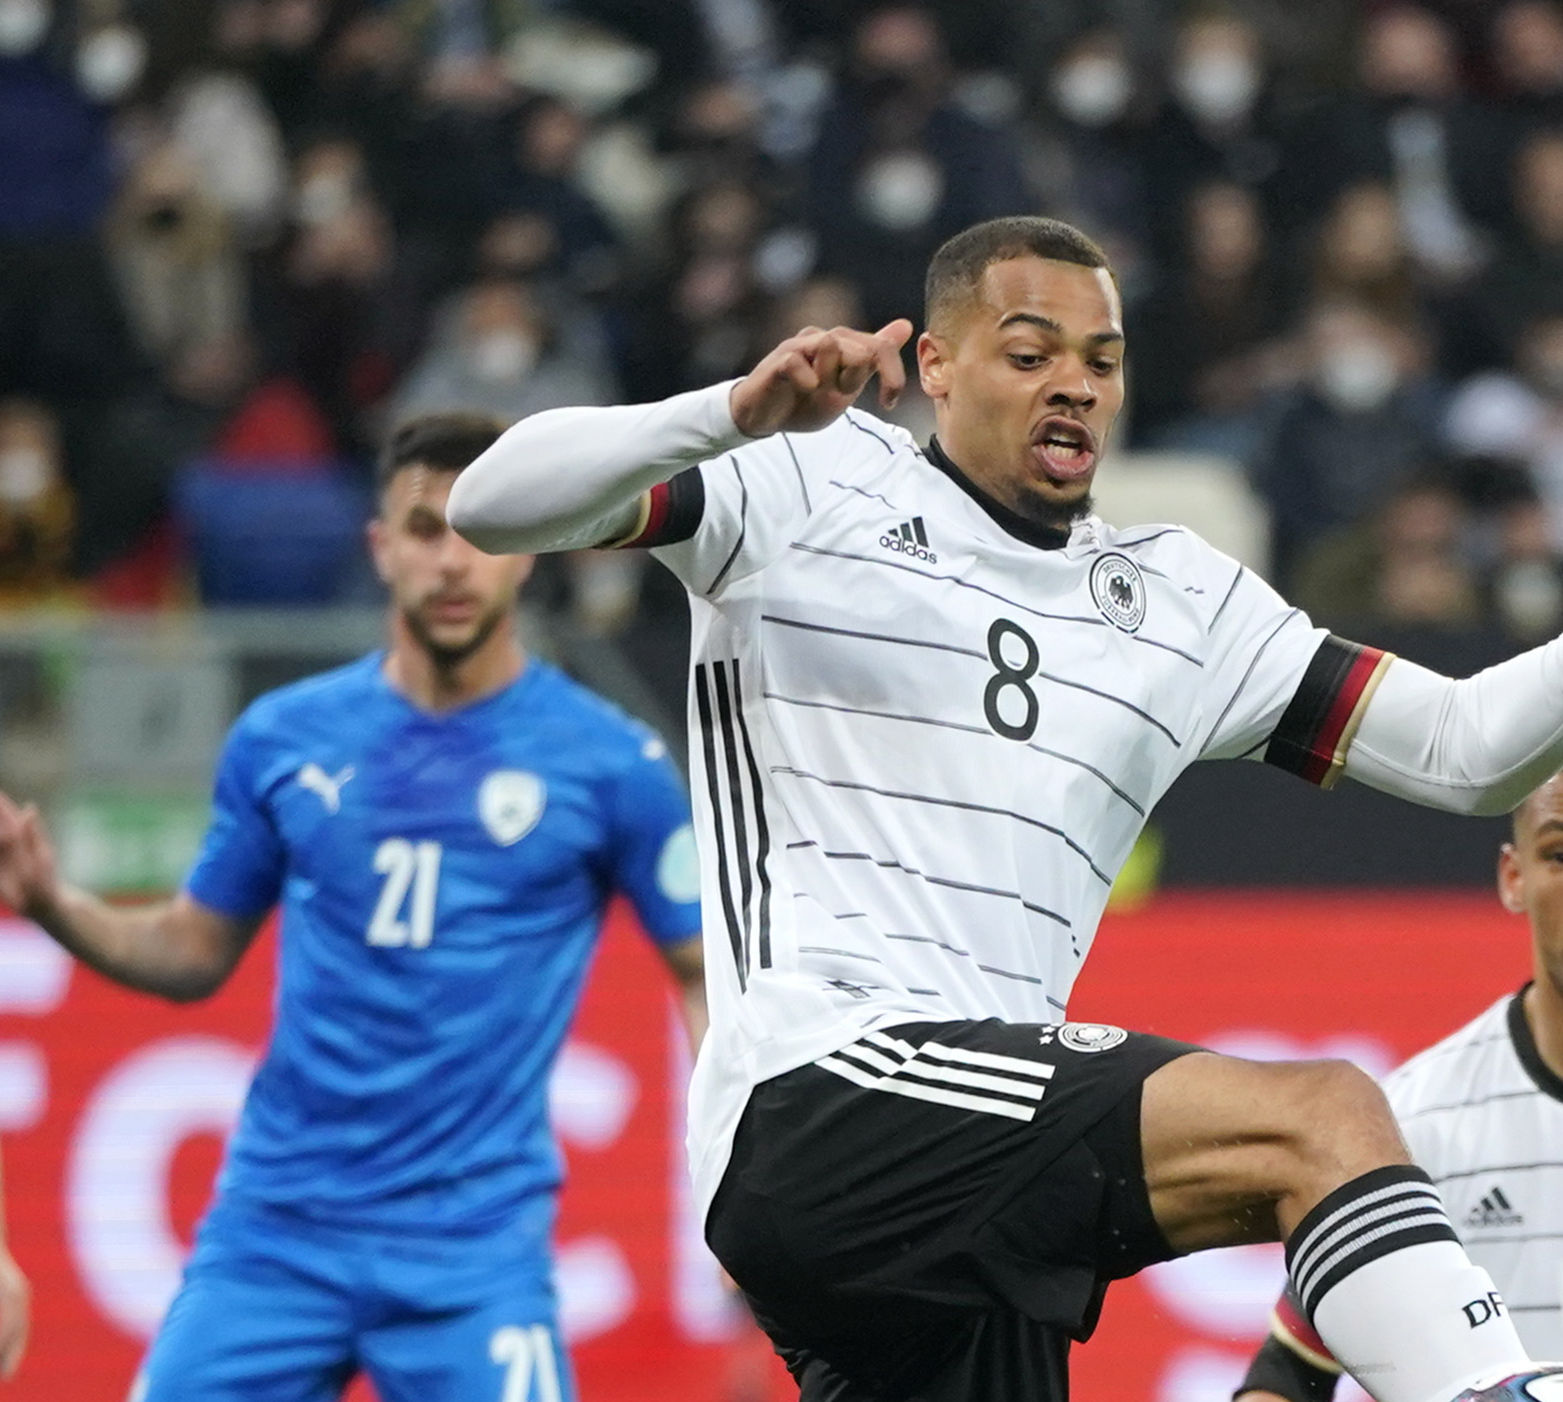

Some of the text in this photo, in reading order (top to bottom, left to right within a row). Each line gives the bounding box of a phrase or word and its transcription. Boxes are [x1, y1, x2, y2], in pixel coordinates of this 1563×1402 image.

[879, 535, 937, 564] adidas
[983, 618, 1040, 741] 8
[366, 838, 443, 949] 21
[1462, 1291, 1505, 1328] DF
